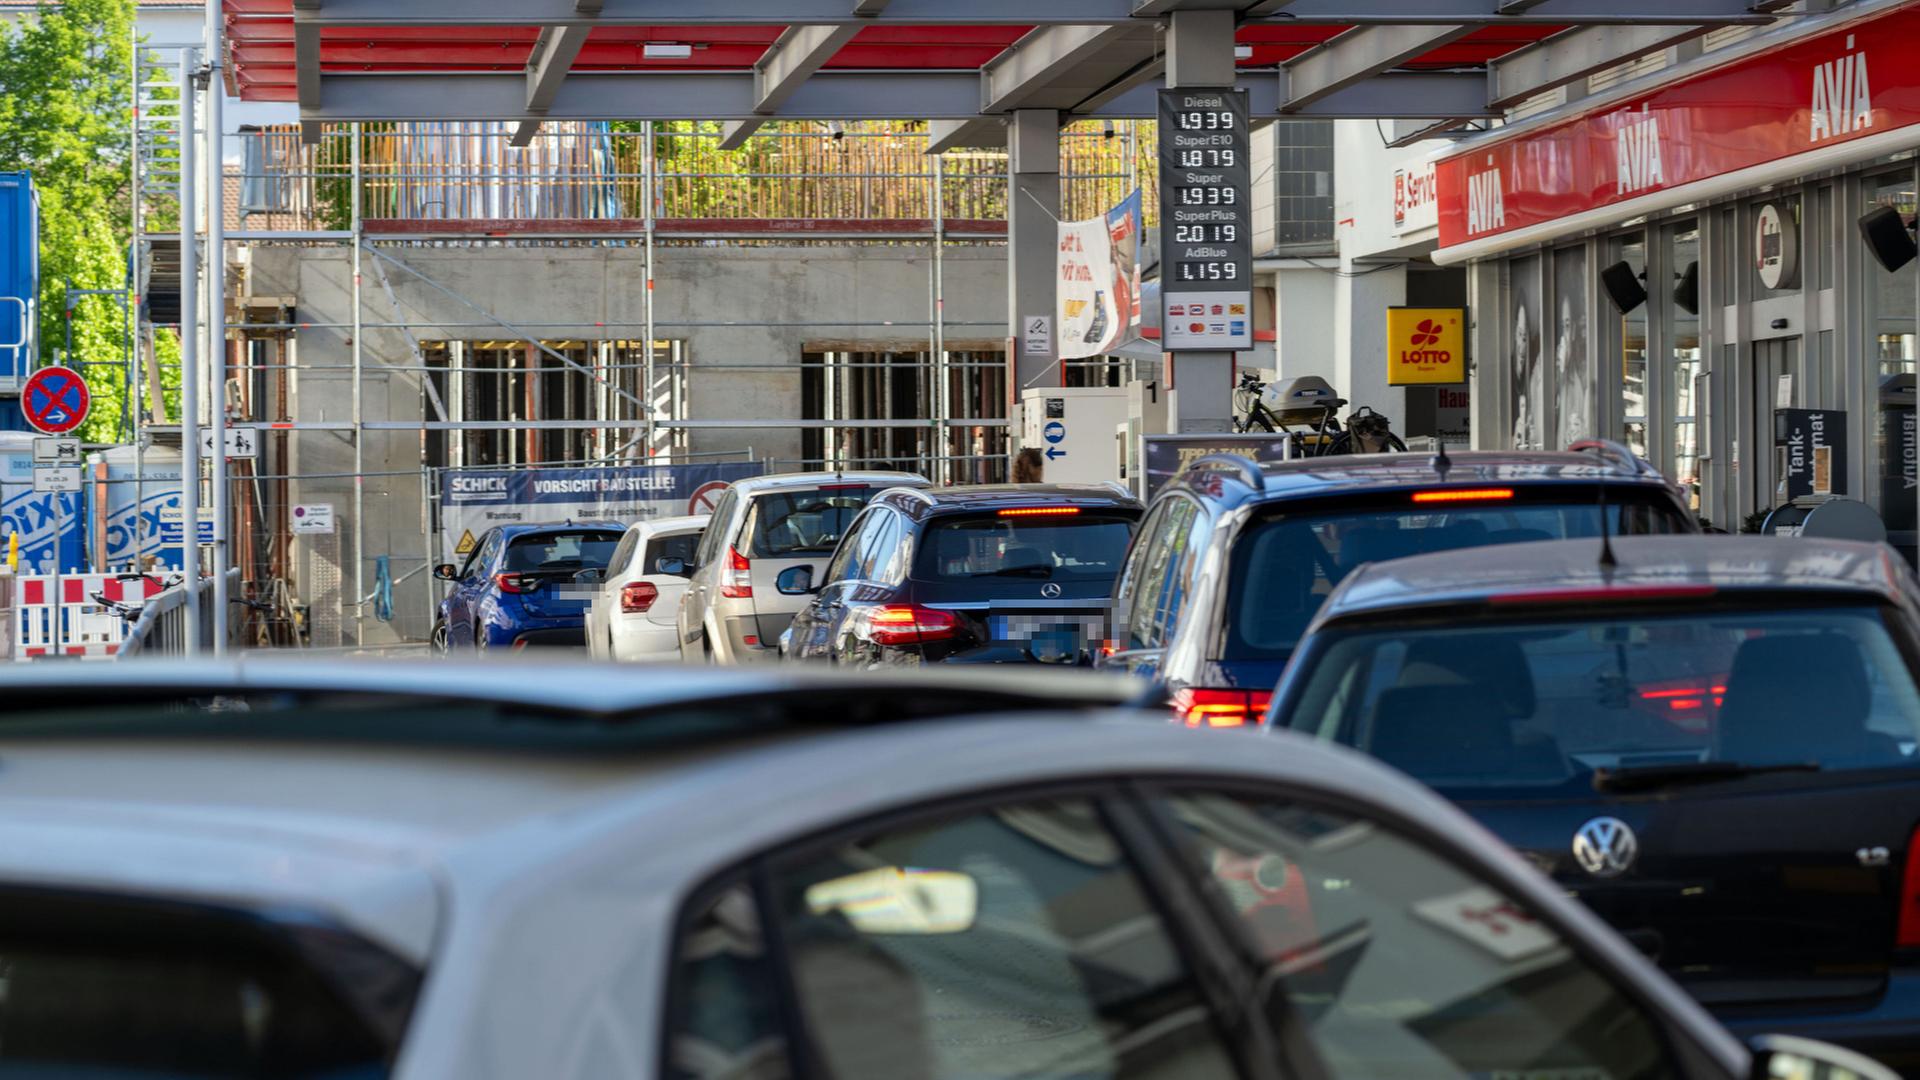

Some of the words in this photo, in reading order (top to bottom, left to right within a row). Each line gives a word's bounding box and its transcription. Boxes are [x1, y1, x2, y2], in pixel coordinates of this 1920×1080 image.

[1184, 97, 1222, 108] Diesel
[1181, 112, 1233, 129] 1.939
[1182, 150, 1234, 167] 1.879
[1186, 173, 1223, 185] Super
[1182, 187, 1235, 205] 1.939
[1407, 171, 1435, 209] Servic
[1175, 225, 1235, 242] 2.019
[1185, 247, 1227, 258] AdBlue
[1184, 263, 1236, 280] 1.159
[1402, 350, 1451, 364] LOTTO
[1146, 381, 1157, 403] 1
[1438, 388, 1469, 409] Hau
[1788, 427, 1804, 477] Tank-
[451, 477, 508, 492] SCHICK
[533, 479, 599, 494] VORSICHT
[601, 477, 676, 492] BAUSTELLE!
